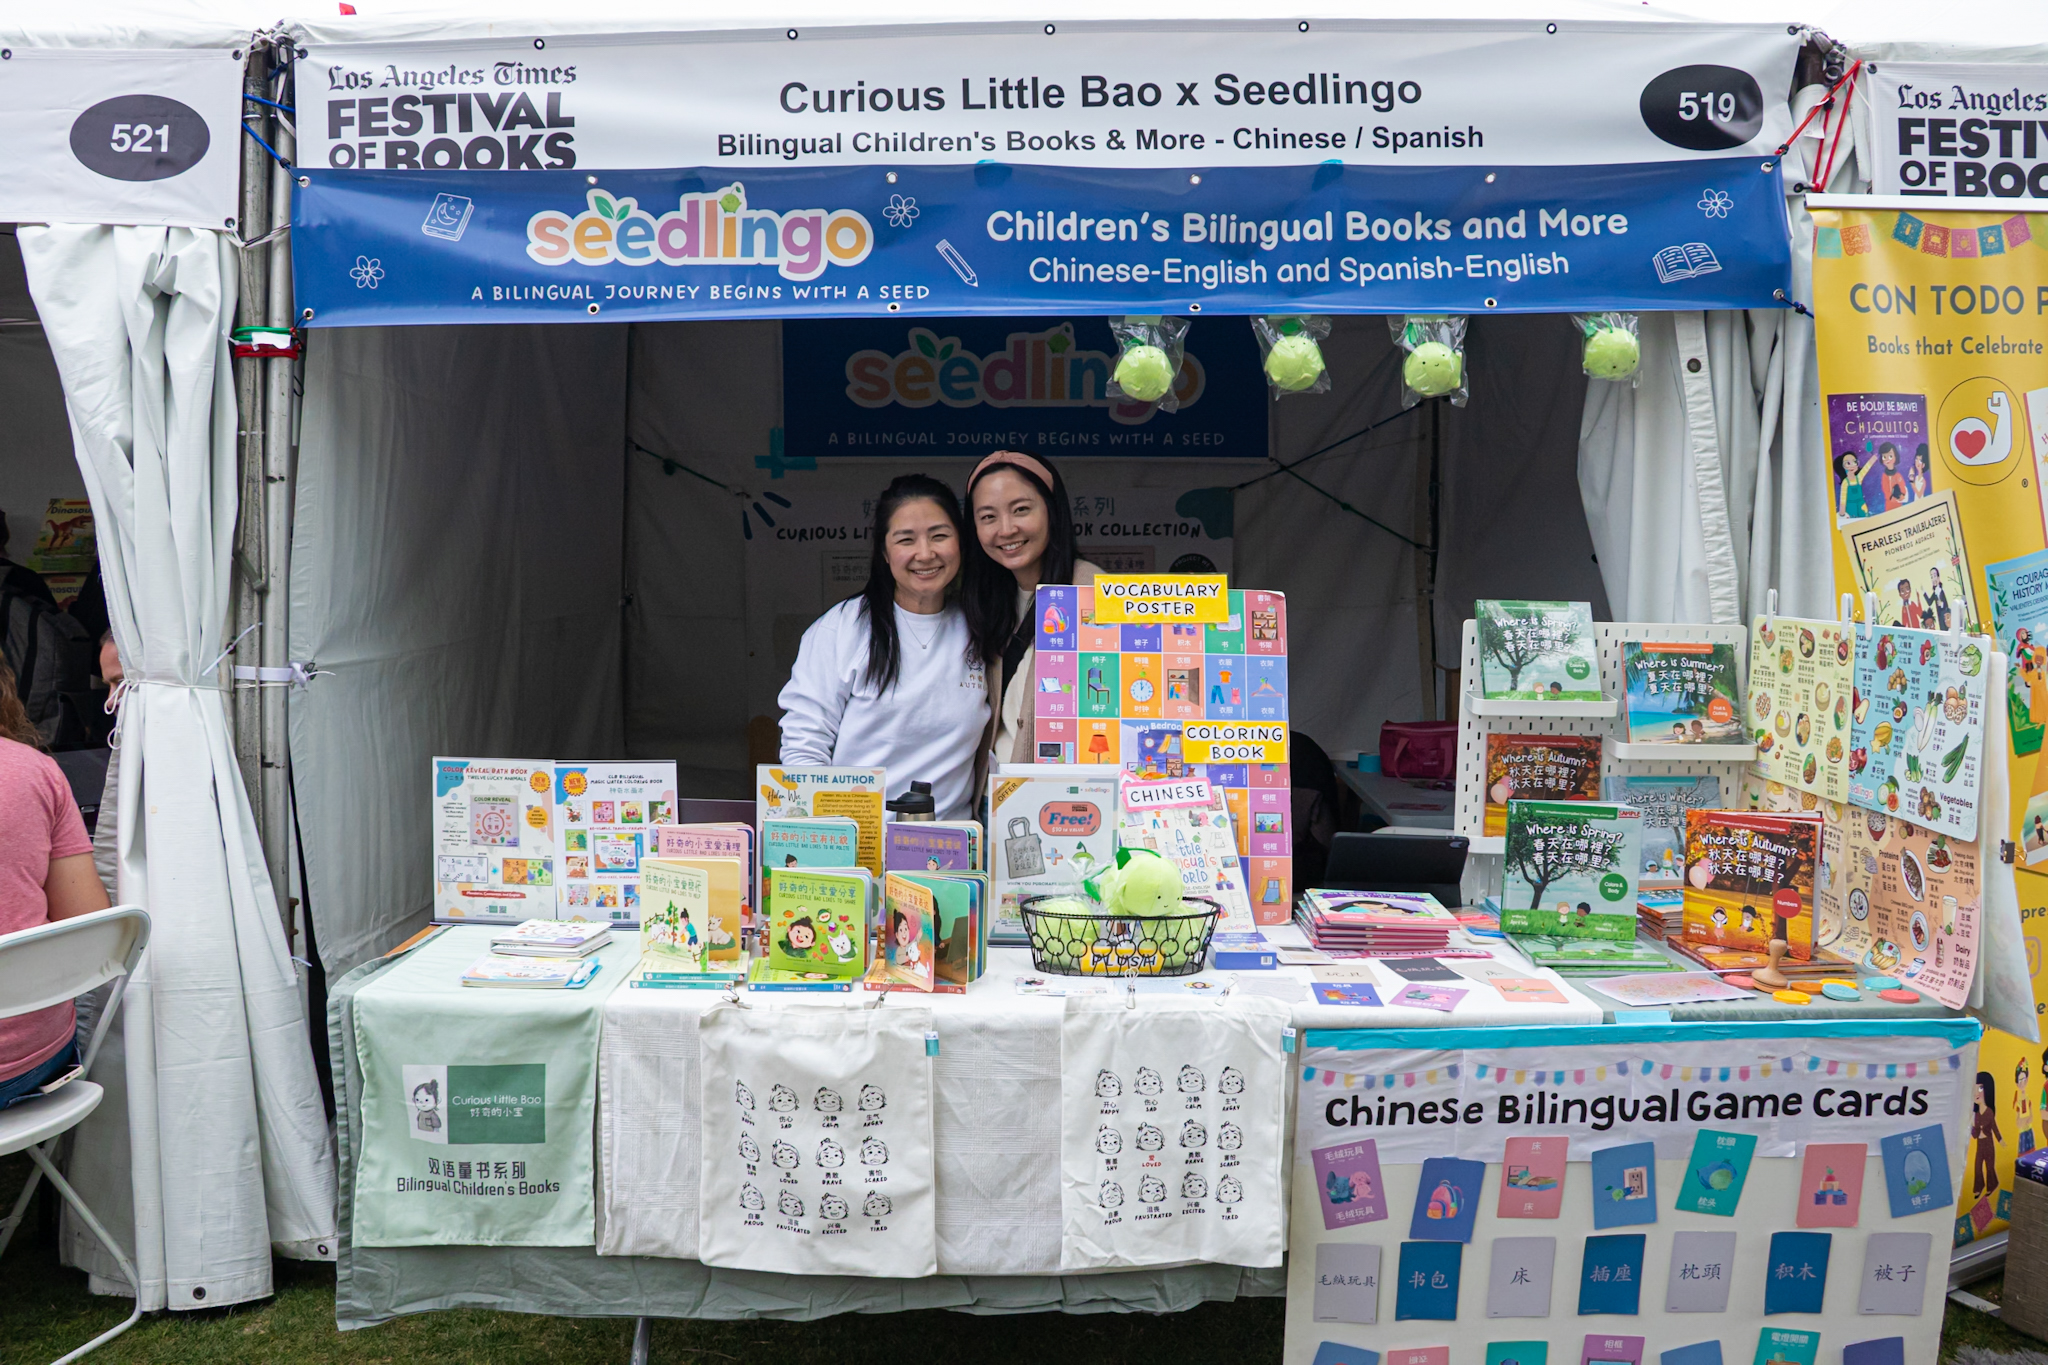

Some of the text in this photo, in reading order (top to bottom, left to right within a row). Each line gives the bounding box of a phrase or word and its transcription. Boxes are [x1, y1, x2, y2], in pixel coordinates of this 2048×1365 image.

[328, 60, 578, 92] Los Angeles Times
[780, 73, 1422, 113] Curious Little Bao x Seedlingo
[1898, 84, 2048, 116] Los Angeles
[1678, 91, 1736, 123] 519
[328, 92, 577, 140] FESTIVAL
[110, 124, 170, 153] 521
[718, 132, 842, 160] Bilingual
[852, 131, 996, 153] Children's
[1006, 130, 1096, 151] Books
[1105, 130, 1127, 150] &
[1136, 129, 1205, 150] More
[1233, 127, 1346, 149] Chinese
[1354, 126, 1363, 149] /
[1371, 126, 1484, 154] Spanish
[329, 132, 577, 170] OF BOOKS
[1900, 160, 1948, 187] OF
[530, 190, 870, 277] seedlingo
[987, 208, 1629, 251] Children's Bilingual Books and More
[1029, 252, 1570, 290] Chinese-English and Spanish-English
[471, 284, 930, 301] A BILINGUAL JOURNEY BEGINS WITH A SEED
[1850, 283, 2025, 315] CON TODO
[1868, 335, 2044, 355] Books that Celebrate
[1846, 401, 1918, 412] BE BOLD! BE BRAVE!
[1845, 420, 1920, 434] CHIQUITOS
[828, 432, 1225, 446] A BILINGUAL JOURNEY BEGINS WITH A SEED
[776, 522, 1202, 543] CURIOUS COLLECTION
[1861, 513, 1947, 553] FEARLESS TRAILBLAZERS
[1102, 584, 1220, 597] VOCABULARY
[1125, 601, 1195, 615] POSTER
[1494, 617, 1577, 631] Where is Spring?
[1635, 657, 1725, 673] Where is Summer?
[1136, 724, 1149, 734] My
[1186, 727, 1283, 742] COLORING
[1212, 747, 1264, 760] BOOK
[1501, 752, 1588, 768] Where is Autumn?
[782, 774, 875, 784] MEET THE AUTHOR
[997, 782, 1018, 802] OFFER
[1130, 784, 1205, 803] CHINESE
[1623, 793, 1705, 805] Where is Winter?
[1939, 792, 1973, 809] Vegetables
[1047, 812, 1093, 826] Free!
[1618, 810, 1641, 818] SAMPLE
[1175, 829, 1186, 844] A
[1526, 824, 1624, 844] Where is Spring?
[1700, 834, 1798, 858] Where is Autumn?
[1879, 849, 1899, 861] Proteins
[1777, 899, 1798, 908] Numbers
[1955, 943, 1971, 957] Dairy
[1091, 954, 1157, 968] PLUSH
[452, 1094, 542, 1106] Curious Little Bao
[1325, 1086, 1929, 1131] Chinese Bilingual Game Cards
[470, 1107, 524, 1118] 好奇的小宝
[1532, 1141, 1542, 1151] 床
[428, 1157, 526, 1180] 双语童书系列
[397, 1177, 561, 1197] Bilingual Children's Books
[1523, 1202, 1534, 1211] 床
[1697, 1196, 1717, 1207] 枕头
[1134, 1212, 1172, 1220] FRUSTRATED
[1221, 1213, 1239, 1221] TIRED
[1408, 1270, 1448, 1289] 书包
[1510, 1267, 1531, 1286] 床
[1590, 1263, 1632, 1283] 插座
[1679, 1263, 1722, 1280] 枕頭
[1775, 1262, 1817, 1281] 积木
[1874, 1264, 1916, 1282] 被子
[1604, 1339, 1623, 1349] 相框
